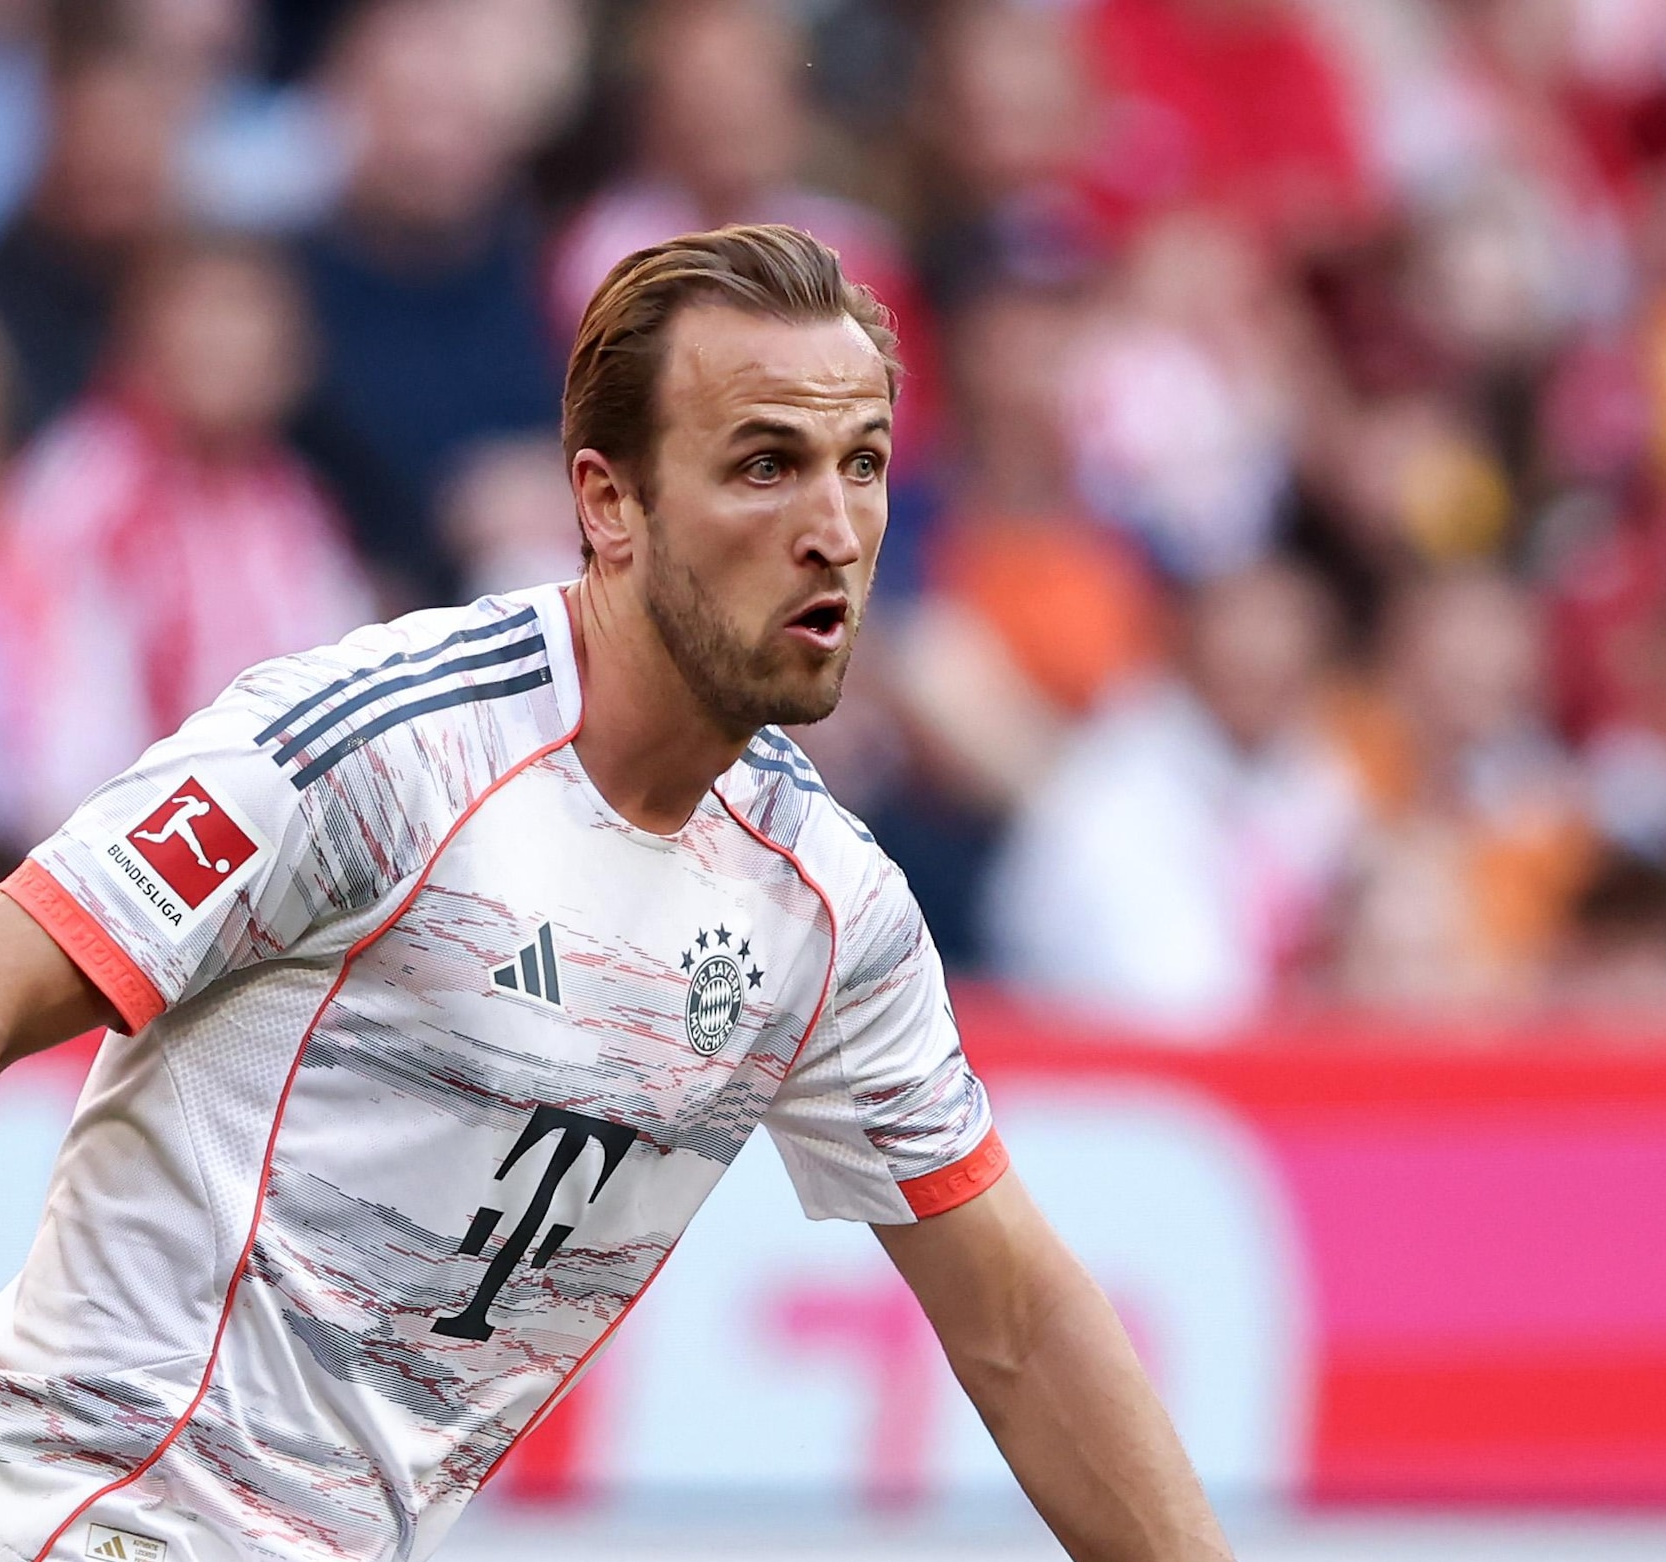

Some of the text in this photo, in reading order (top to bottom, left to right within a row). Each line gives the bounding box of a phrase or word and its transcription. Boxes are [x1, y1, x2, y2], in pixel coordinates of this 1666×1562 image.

[107, 844, 184, 926] BUNDESLIGA
[694, 962, 741, 1003] FC BAYERN
[431, 1103, 638, 1342] T
